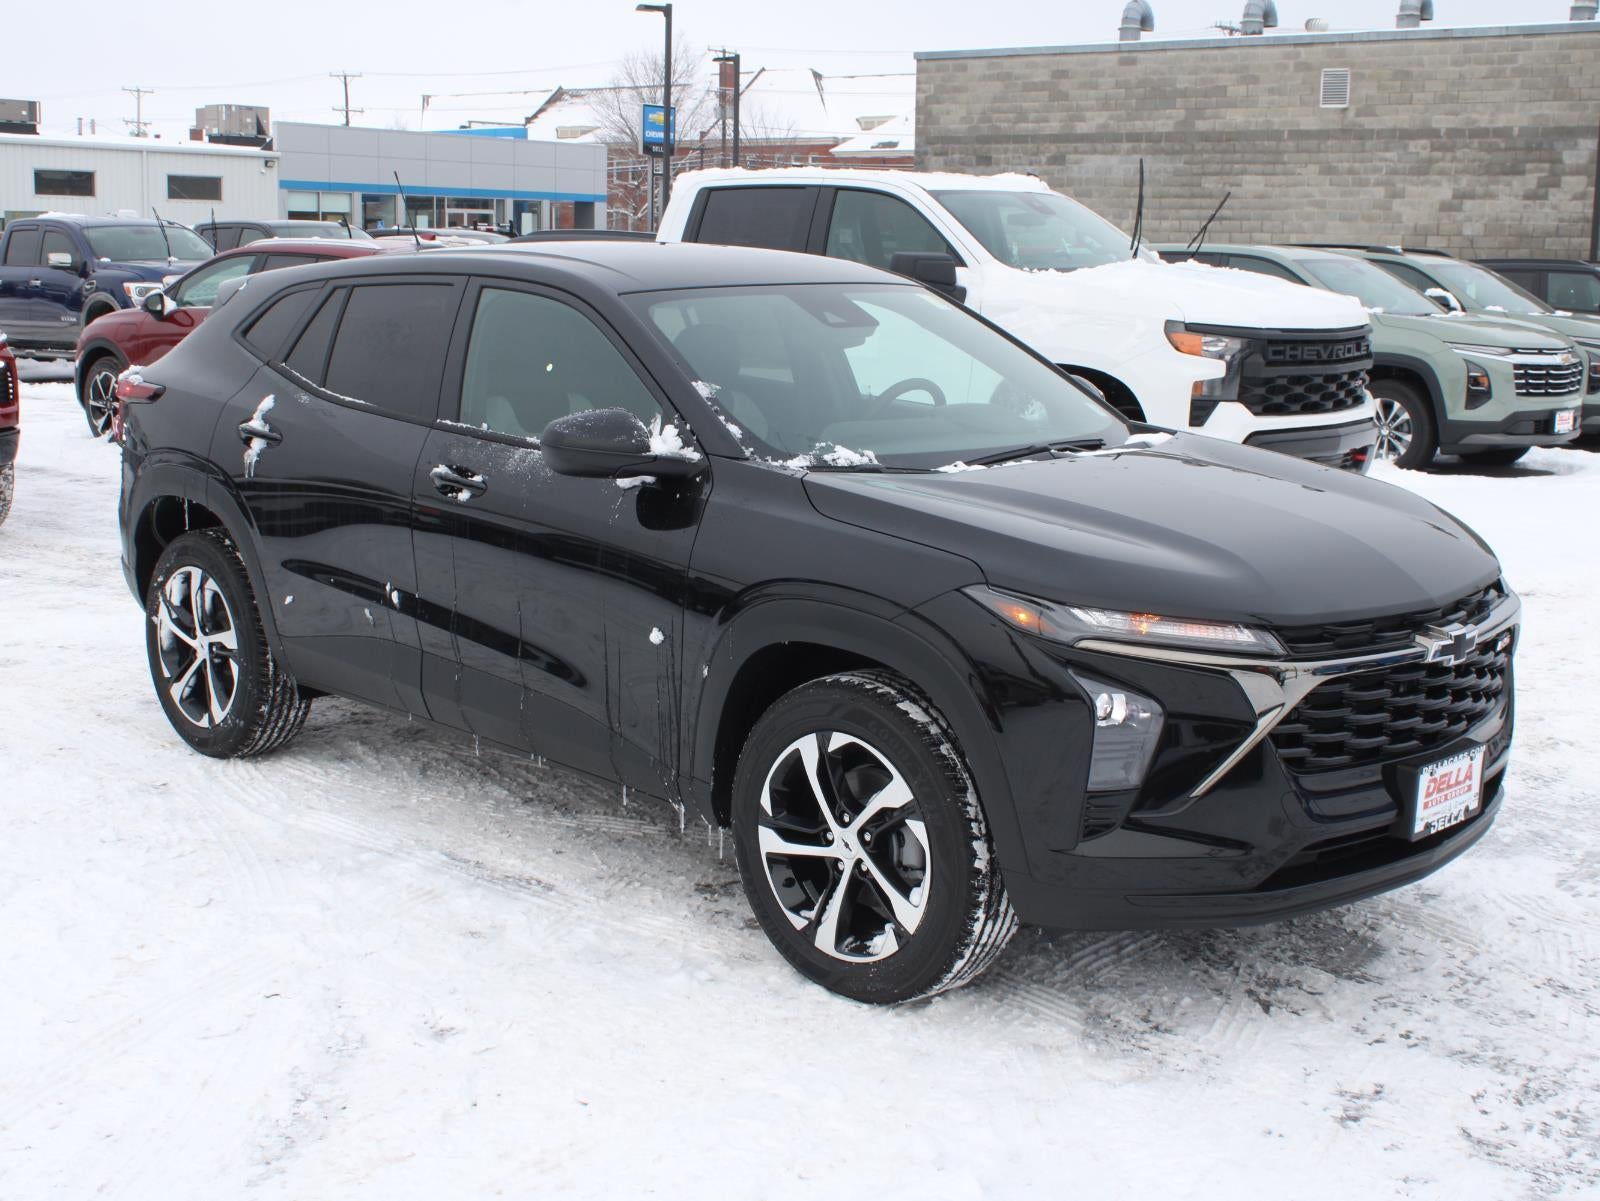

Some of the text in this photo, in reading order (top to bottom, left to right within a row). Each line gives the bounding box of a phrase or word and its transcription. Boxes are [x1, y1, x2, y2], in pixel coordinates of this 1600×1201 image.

[1267, 342, 1371, 361] CHEVROLE
[1424, 764, 1473, 798] DELLA
[1427, 786, 1469, 807] AUTO GROUP
[1430, 807, 1465, 834] DELLA
